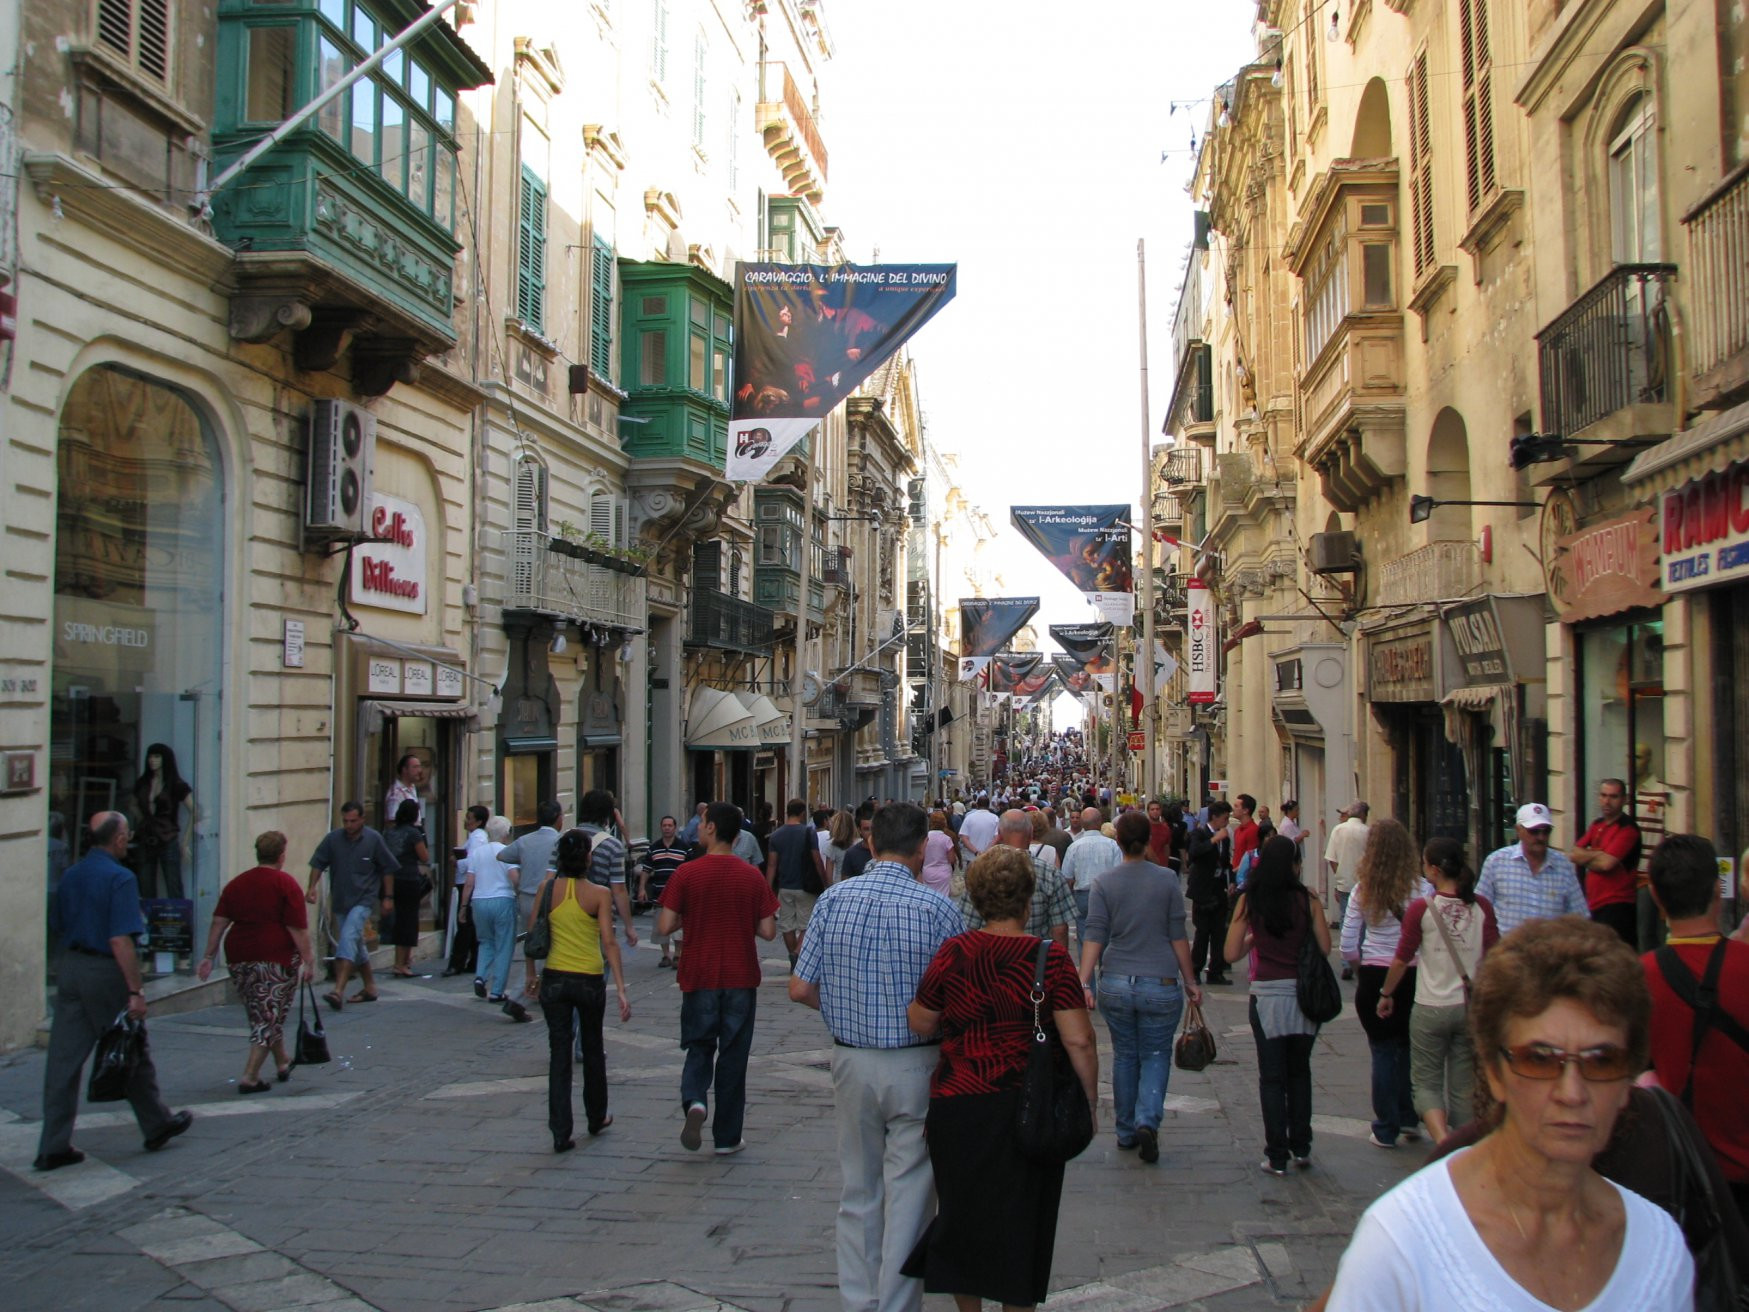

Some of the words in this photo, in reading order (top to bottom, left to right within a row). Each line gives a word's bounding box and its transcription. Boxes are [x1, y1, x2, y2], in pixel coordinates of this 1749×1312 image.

[745, 271, 815, 284] CARAVAGGIO:
[831, 272, 885, 284] IMMAGINE
[888, 272, 909, 284] DEL
[911, 272, 948, 285] DIVINO
[64, 621, 149, 648] SPRINGFIELD
[1192, 629, 1204, 672] HSBC
[1450, 610, 1502, 656] PULSAR
